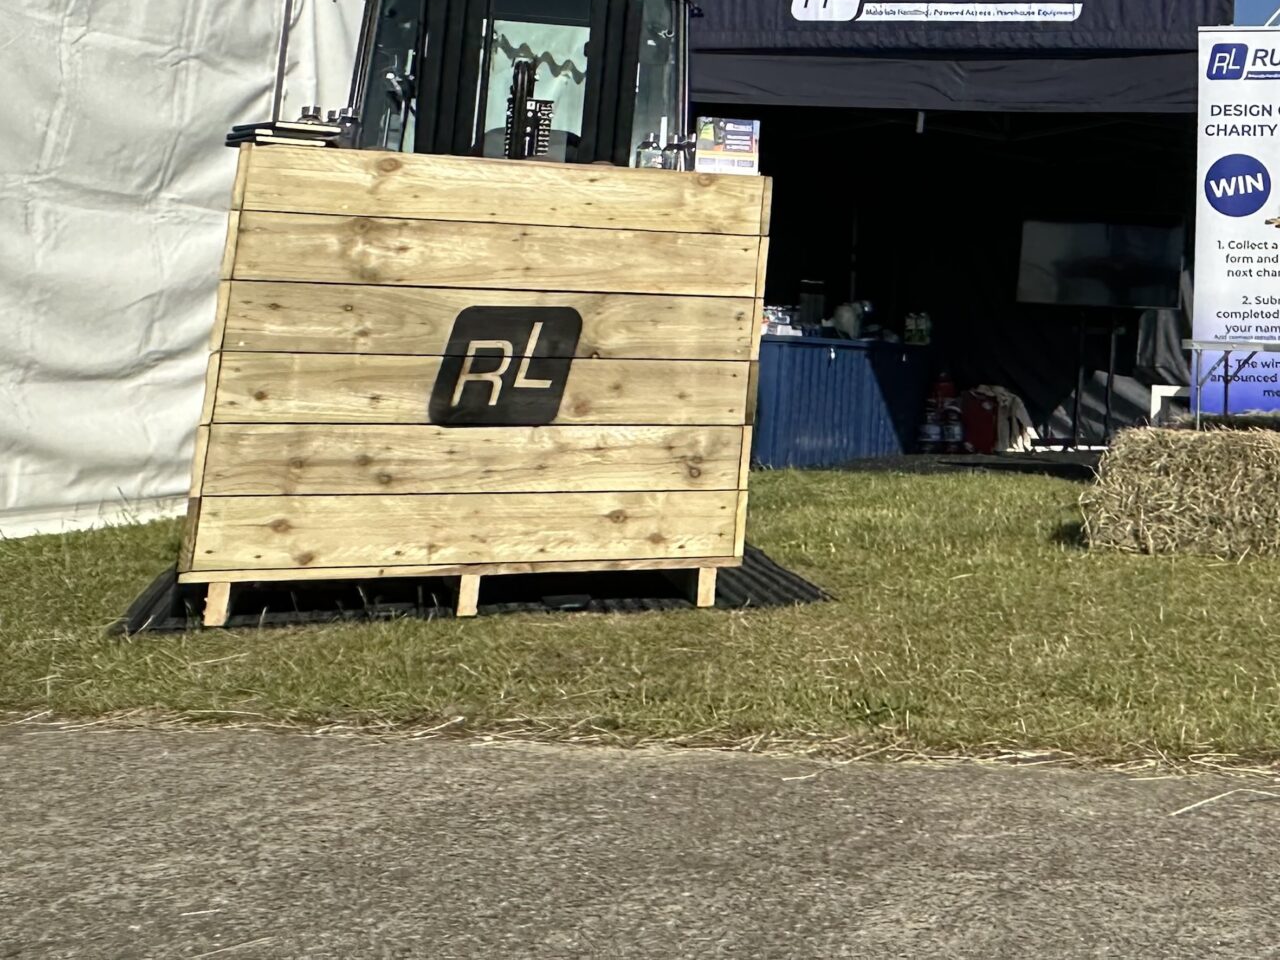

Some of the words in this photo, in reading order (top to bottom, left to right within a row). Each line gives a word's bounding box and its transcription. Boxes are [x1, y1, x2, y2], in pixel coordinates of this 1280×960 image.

[1210, 104, 1273, 117] DESIGN
[1205, 124, 1278, 137] CHARITY
[1209, 172, 1264, 198] WIN
[1217, 240, 1225, 250] 1.
[1228, 240, 1270, 250] Collect
[1271, 242, 1279, 250] a
[1225, 254, 1253, 264] form
[1257, 254, 1279, 264] and
[1227, 268, 1253, 278] next
[1242, 296, 1252, 305] 2.
[1216, 309, 1280, 321] completed
[1225, 324, 1252, 335] your
[451, 321, 553, 407] RL
[1210, 373, 1278, 383] anounced
